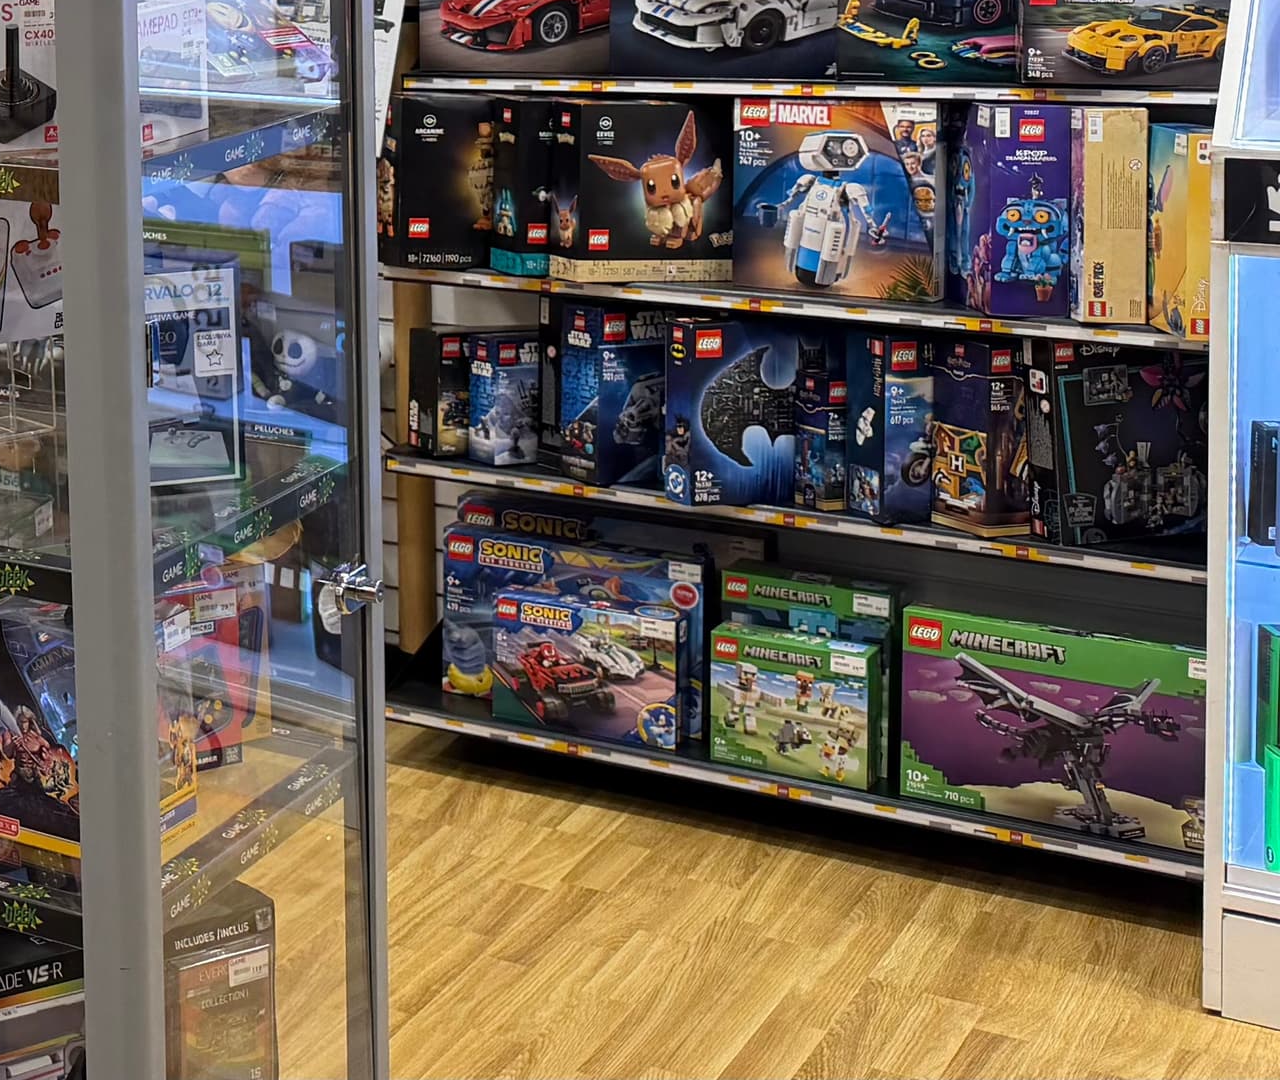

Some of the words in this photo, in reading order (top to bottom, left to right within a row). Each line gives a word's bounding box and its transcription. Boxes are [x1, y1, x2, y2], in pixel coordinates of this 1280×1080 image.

[742, 105, 768, 118] LEGO
[778, 104, 830, 125] MARVEL
[449, 541, 473, 553] LEGO
[482, 541, 542, 561] SONIC
[726, 580, 747, 593] LEGO
[753, 583, 832, 607] MINECRAFT
[911, 625, 940, 640] LEGO
[949, 629, 1066, 664] MINECRAFT
[906, 769, 929, 782] 10+
[944, 790, 959, 801] 710
[960, 795, 975, 805] pcs
[28, 961, 62, 987] VS-R
